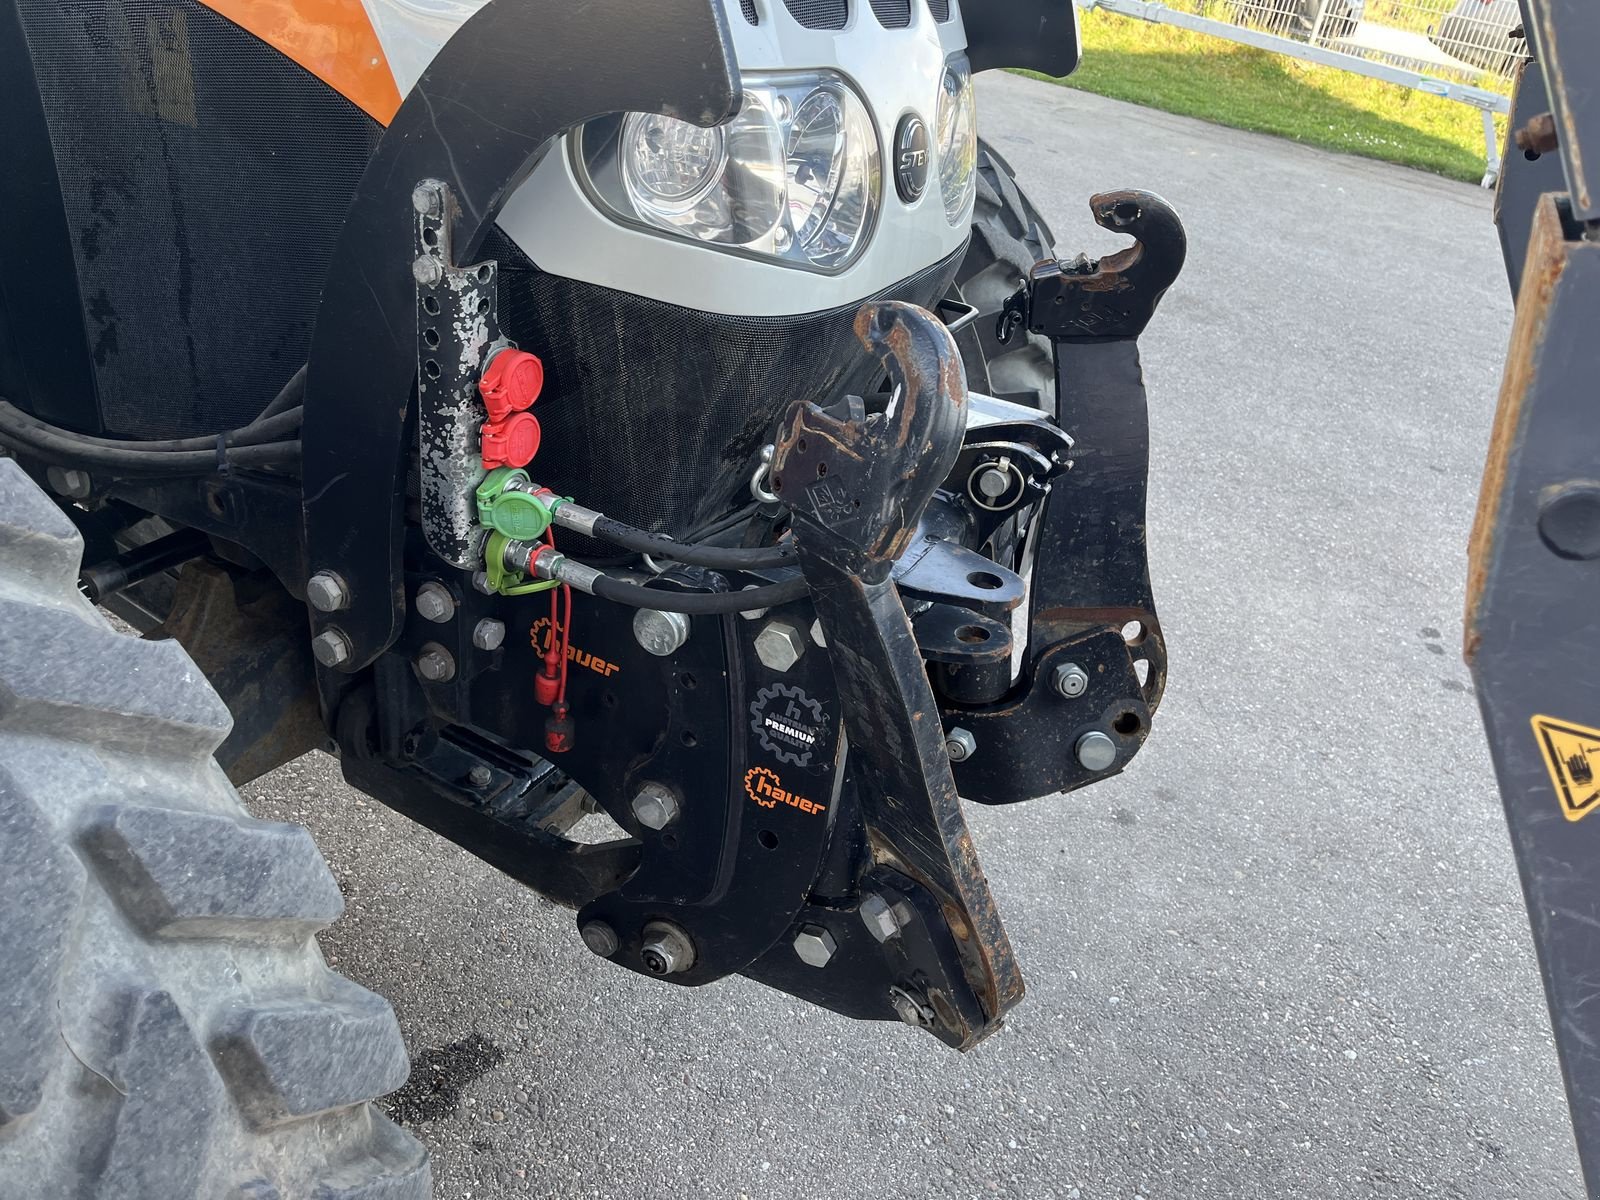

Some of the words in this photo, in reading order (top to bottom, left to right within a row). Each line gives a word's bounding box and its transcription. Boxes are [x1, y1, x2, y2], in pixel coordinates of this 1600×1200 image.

[765, 718, 816, 745] PREMIUM
[769, 730, 811, 751] QUALITY
[756, 775, 826, 815] hauer
